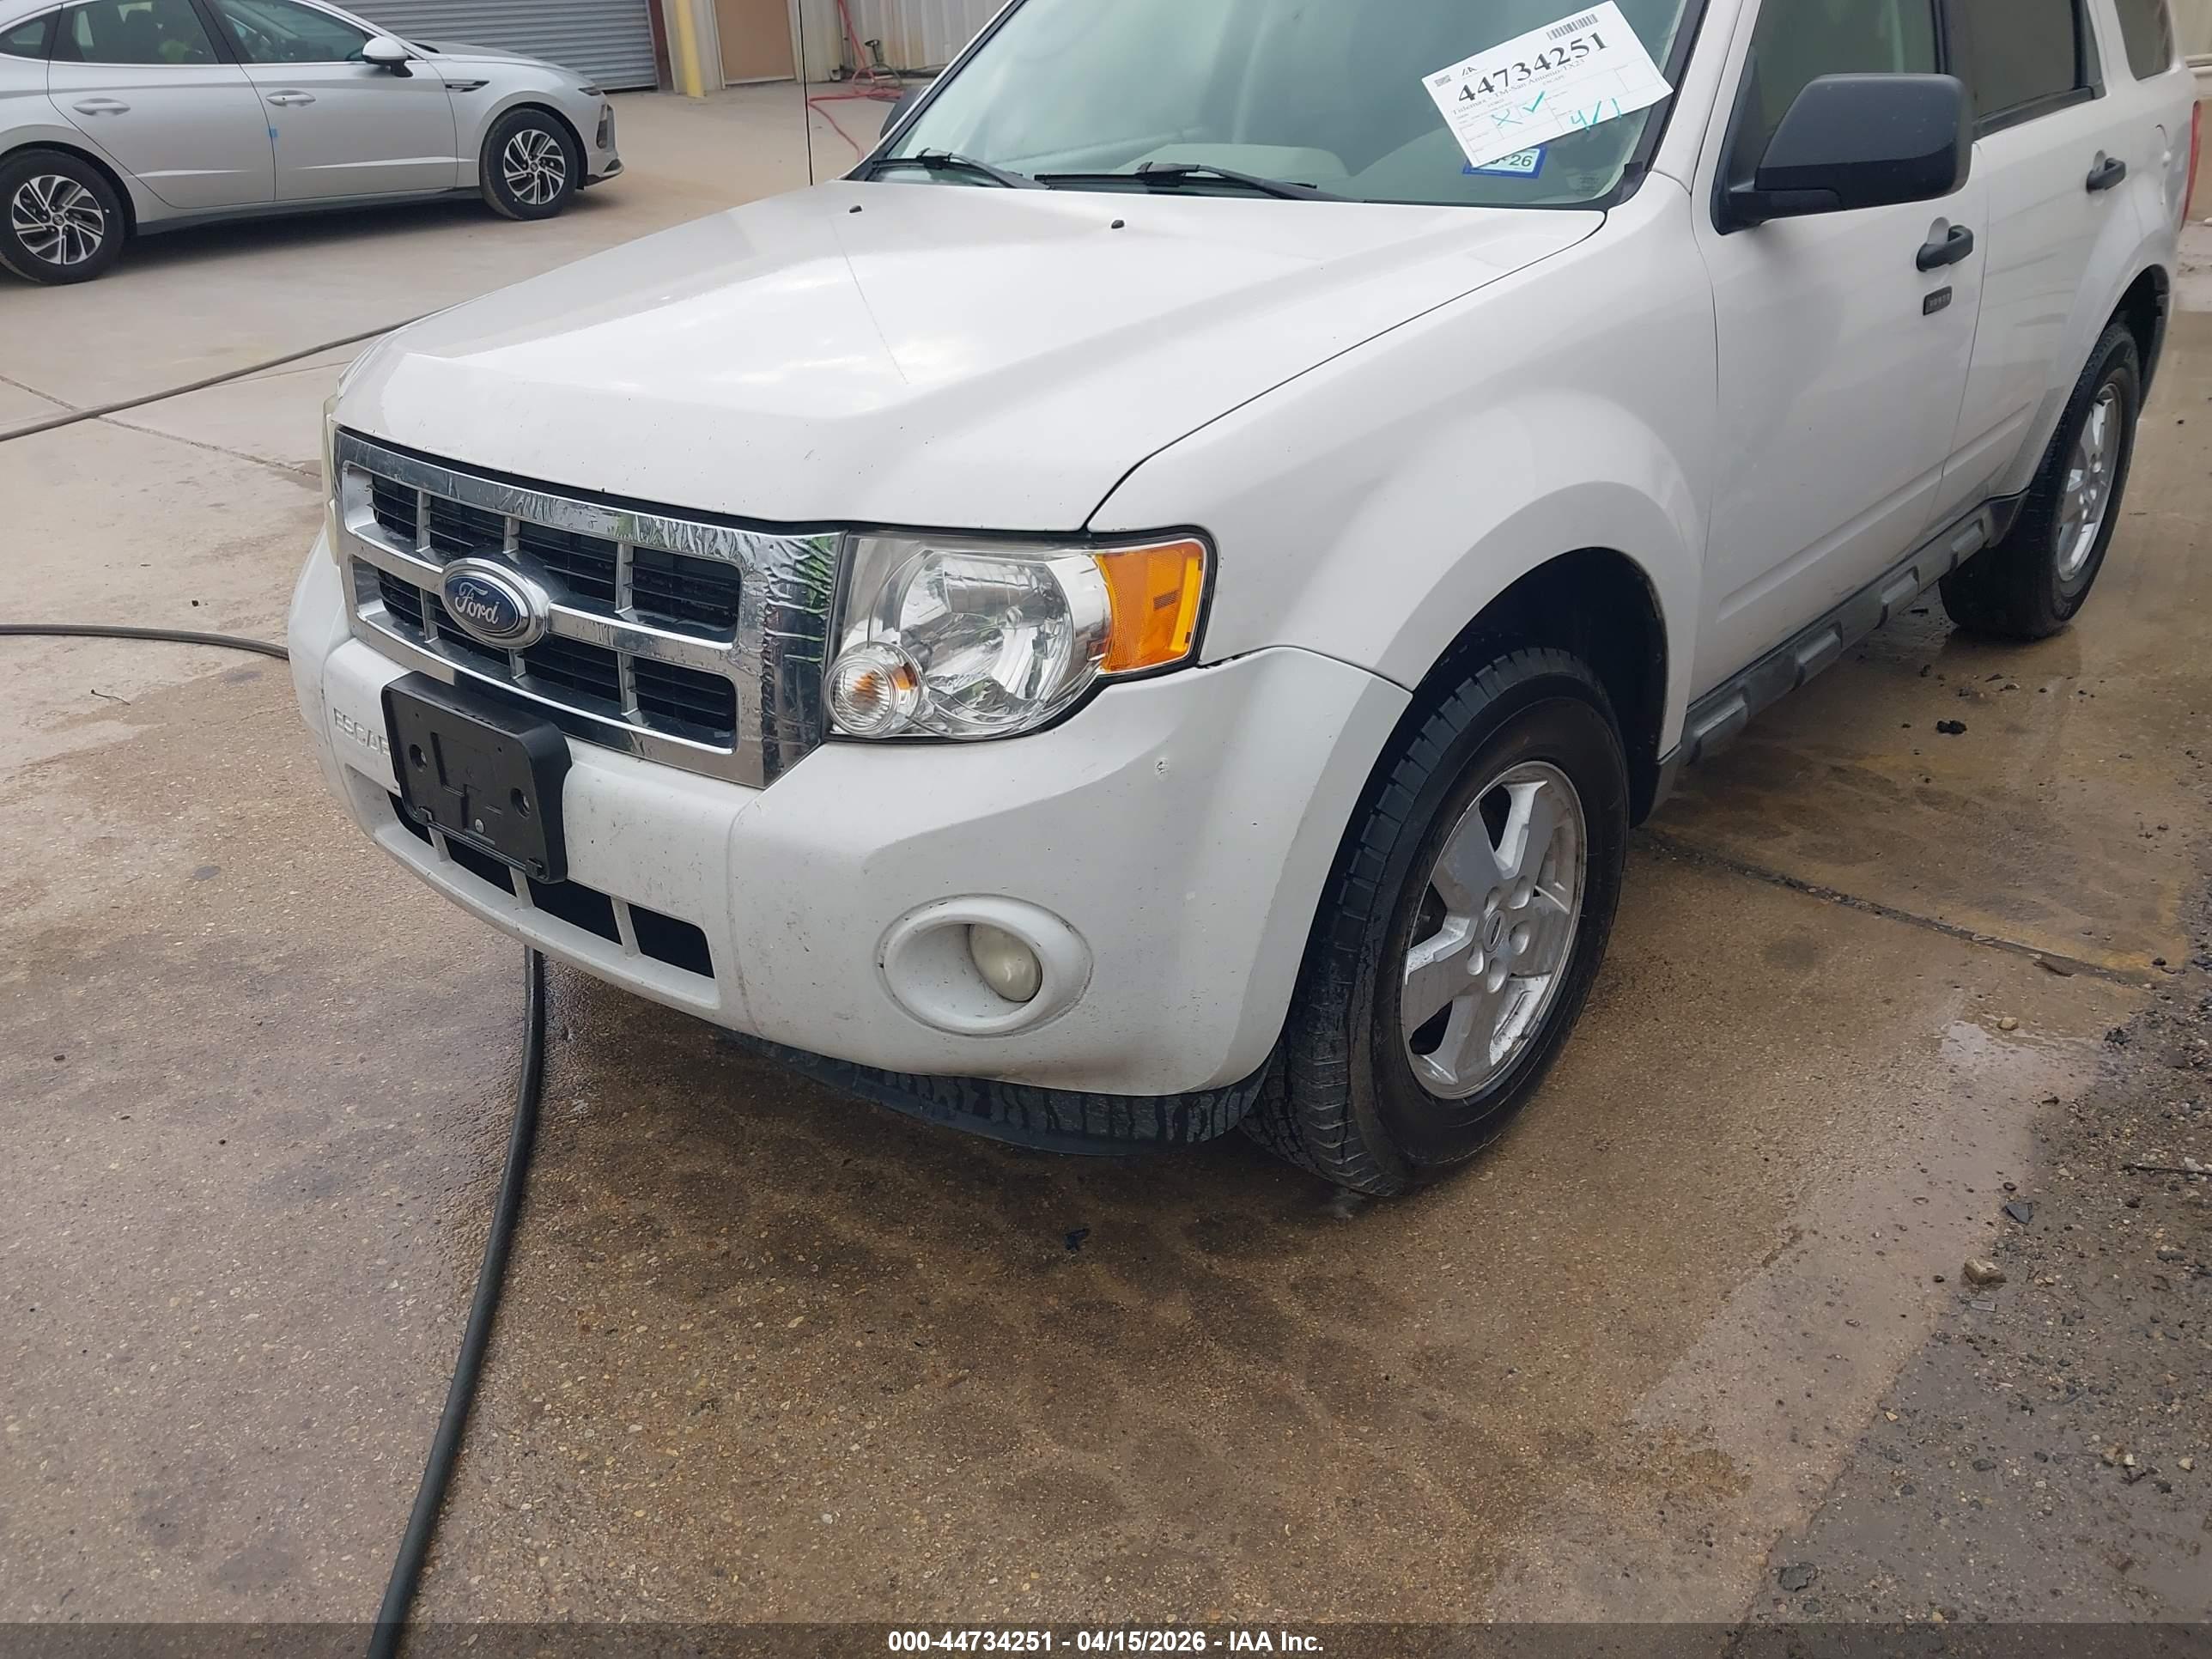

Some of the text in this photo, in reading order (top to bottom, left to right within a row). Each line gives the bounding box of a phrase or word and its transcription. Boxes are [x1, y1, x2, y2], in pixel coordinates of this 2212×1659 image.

[1458, 32, 1607, 101] 44734251
[454, 581, 500, 624] Ford
[333, 707, 391, 757] ESCAP
